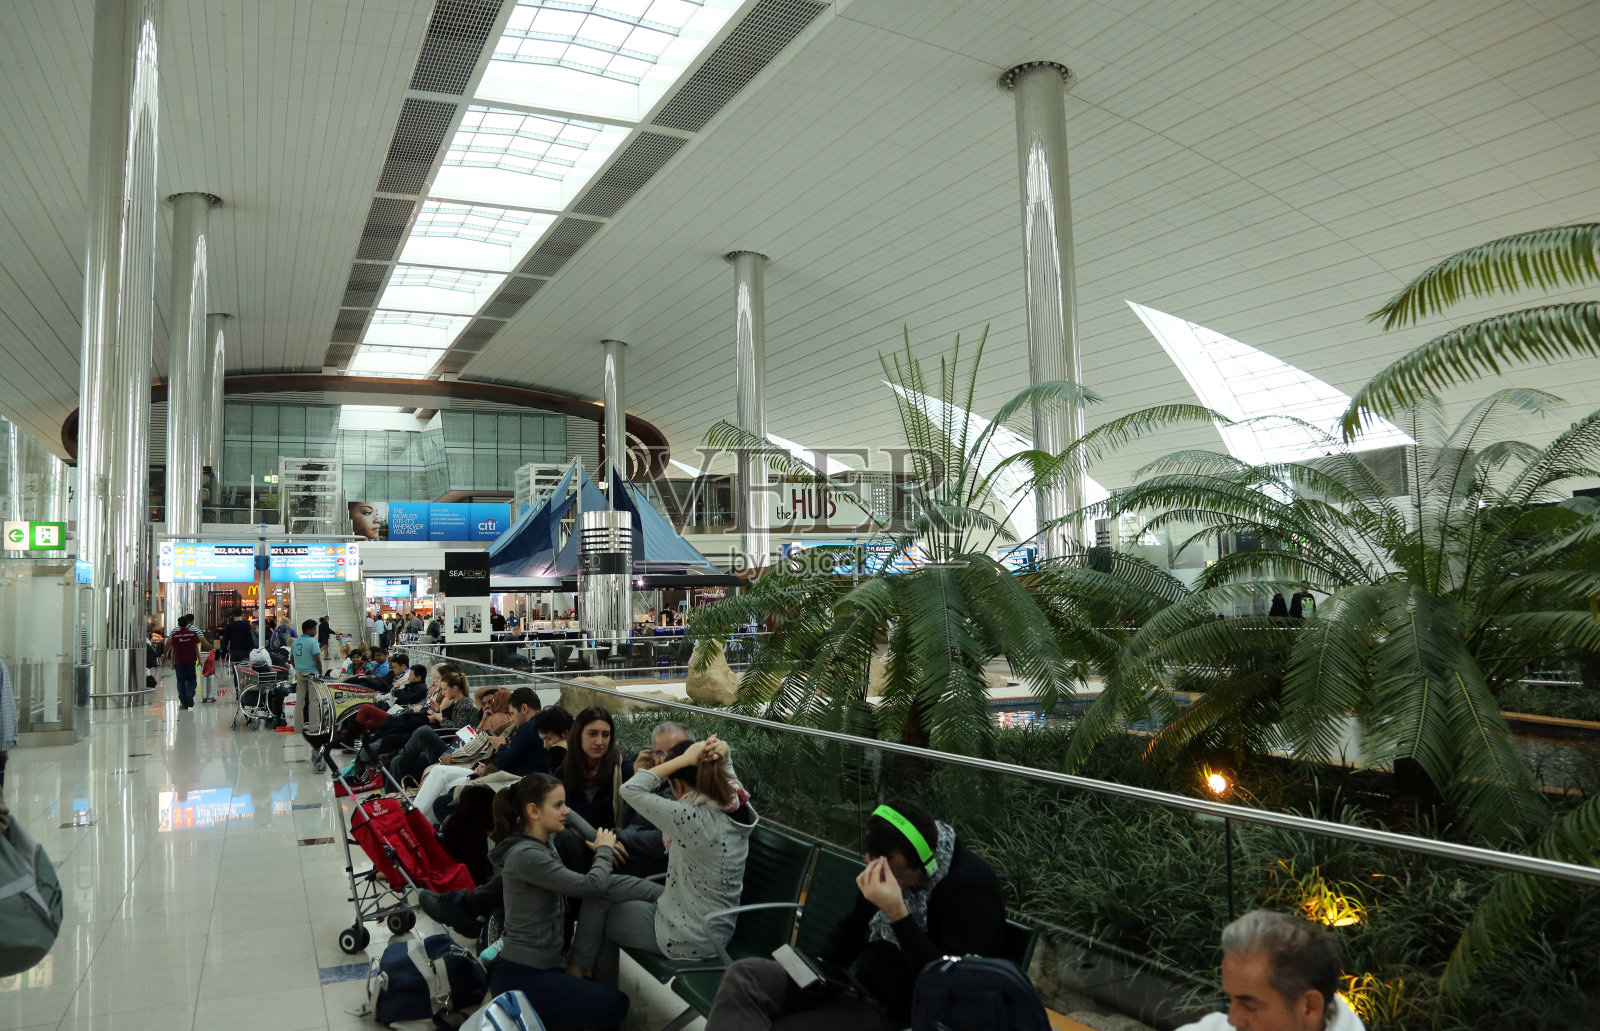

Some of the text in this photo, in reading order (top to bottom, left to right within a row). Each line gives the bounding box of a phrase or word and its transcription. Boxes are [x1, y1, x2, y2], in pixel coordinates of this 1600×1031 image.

[777, 489, 836, 519] the HUB
[296, 643, 303, 656] 3
